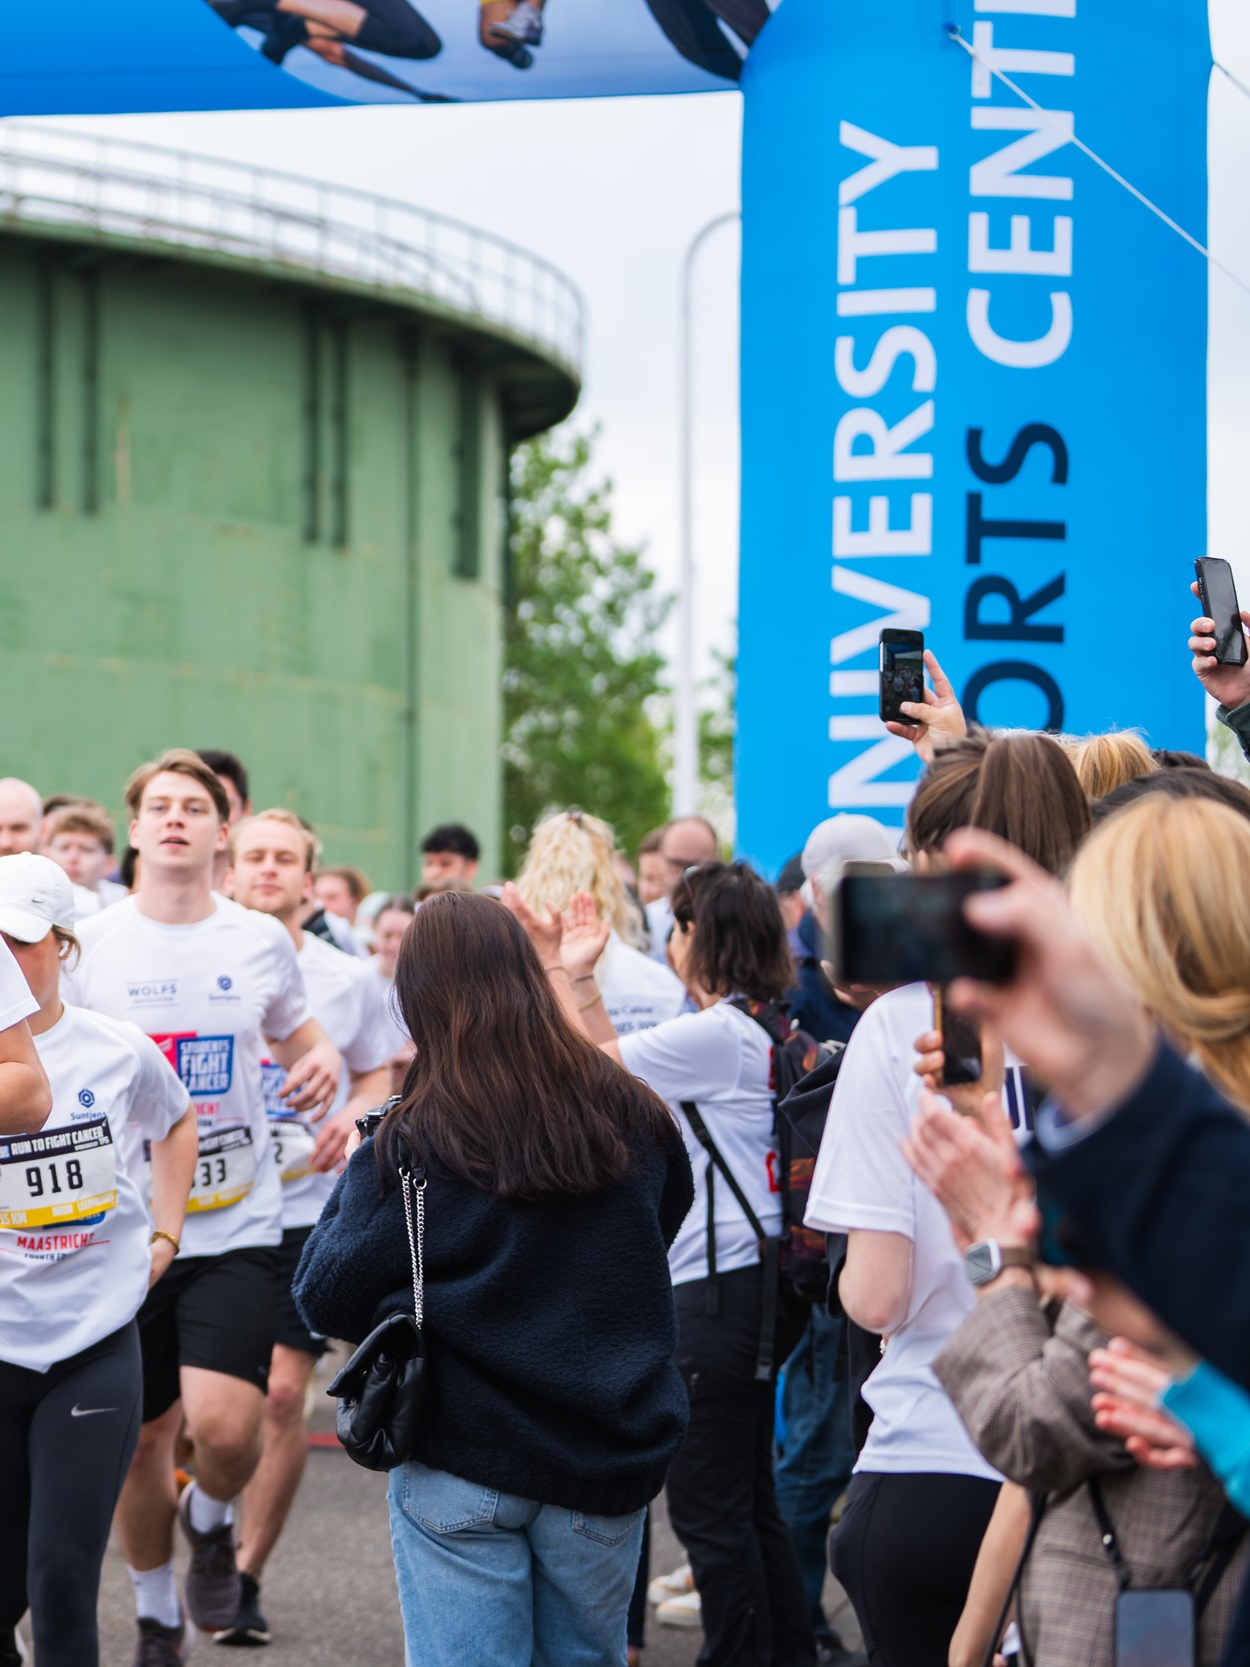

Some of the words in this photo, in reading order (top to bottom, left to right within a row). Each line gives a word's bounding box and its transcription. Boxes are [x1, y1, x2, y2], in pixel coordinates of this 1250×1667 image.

[966, 0, 1077, 368] CENT
[828, 120, 939, 820] NIVERSITY
[128, 983, 177, 997] WOLFS
[180, 1039, 230, 1052] STUDENTS
[180, 1052, 229, 1075] FIGHT
[181, 1072, 229, 1092] CANCER
[10, 1141, 32, 1156] RUN
[32, 1139, 45, 1152] TO
[44, 1133, 72, 1150] FIGHT
[72, 1126, 104, 1144] CANCER
[26, 1159, 83, 1197] 918
[191, 1158, 227, 1188] 33
[17, 1232, 95, 1251] MAASTRICHT
